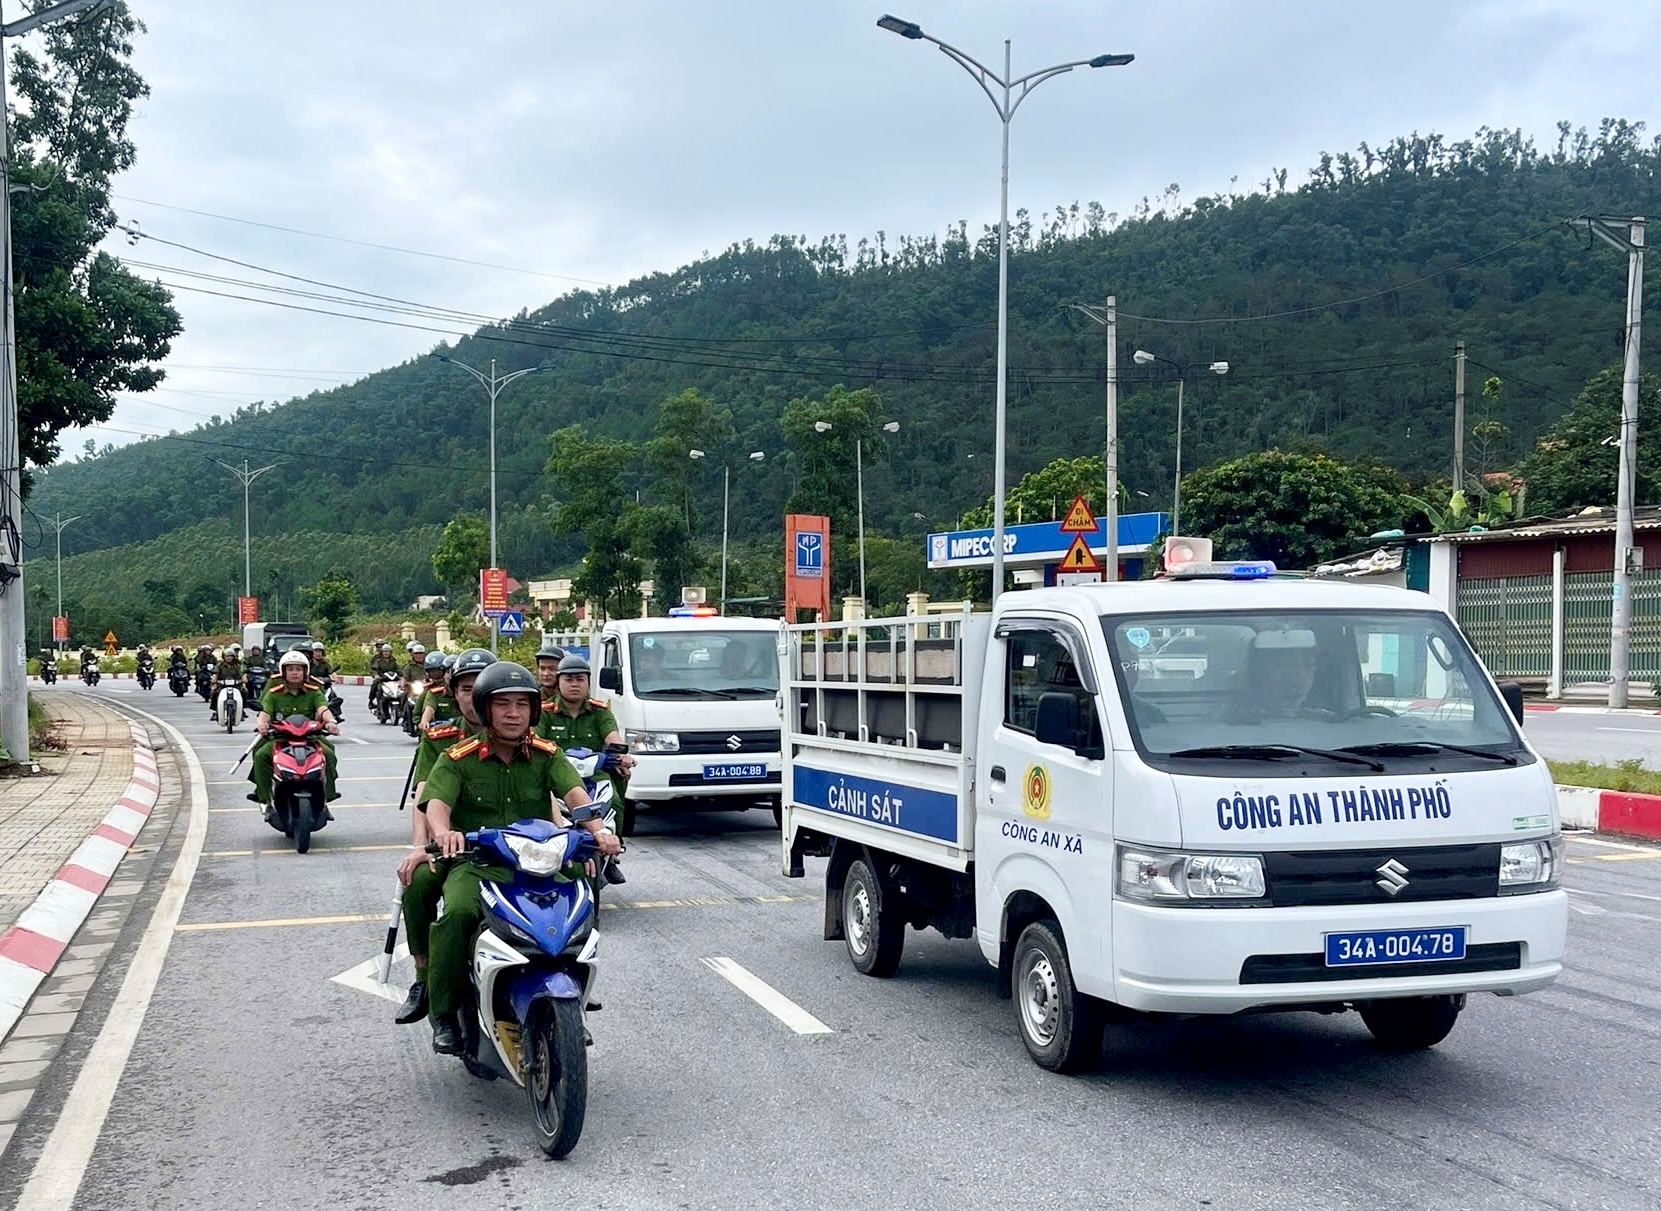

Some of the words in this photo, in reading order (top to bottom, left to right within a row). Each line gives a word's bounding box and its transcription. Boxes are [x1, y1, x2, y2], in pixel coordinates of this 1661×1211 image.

[828, 778, 867, 817] CẢNH
[871, 789, 903, 825] SÁT
[1216, 791, 1282, 831] CÔNG
[1289, 792, 1323, 826] AN
[1327, 785, 1405, 823] THÀNH
[1407, 778, 1452, 820] PHỐ
[1001, 819, 1038, 843] CÔNG
[1040, 831, 1061, 849] AN
[1063, 833, 1083, 855] XÃ
[1338, 933, 1455, 960] 34A-004.78
